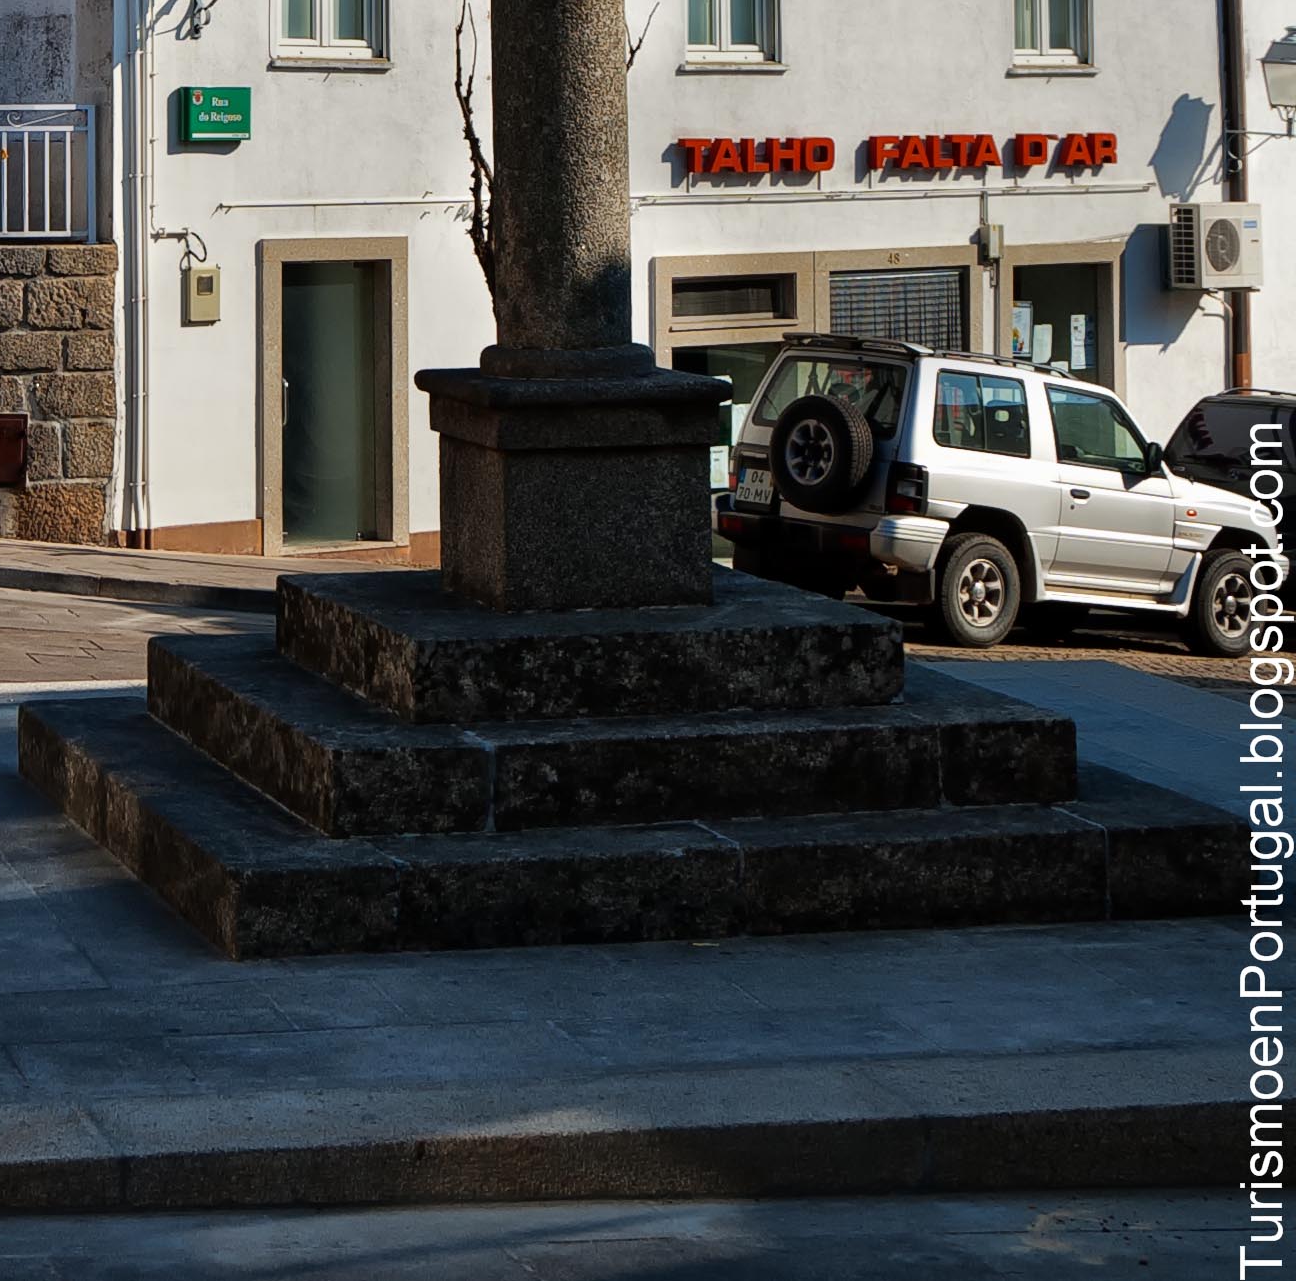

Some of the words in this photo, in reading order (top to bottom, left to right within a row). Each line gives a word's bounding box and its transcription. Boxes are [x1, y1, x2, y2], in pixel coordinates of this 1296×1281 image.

[211, 96, 229, 107] Rua
[198, 111, 209, 122] do
[679, 137, 835, 173] TALHO
[869, 133, 1003, 169] FALTA
[751, 471, 764, 483] 04
